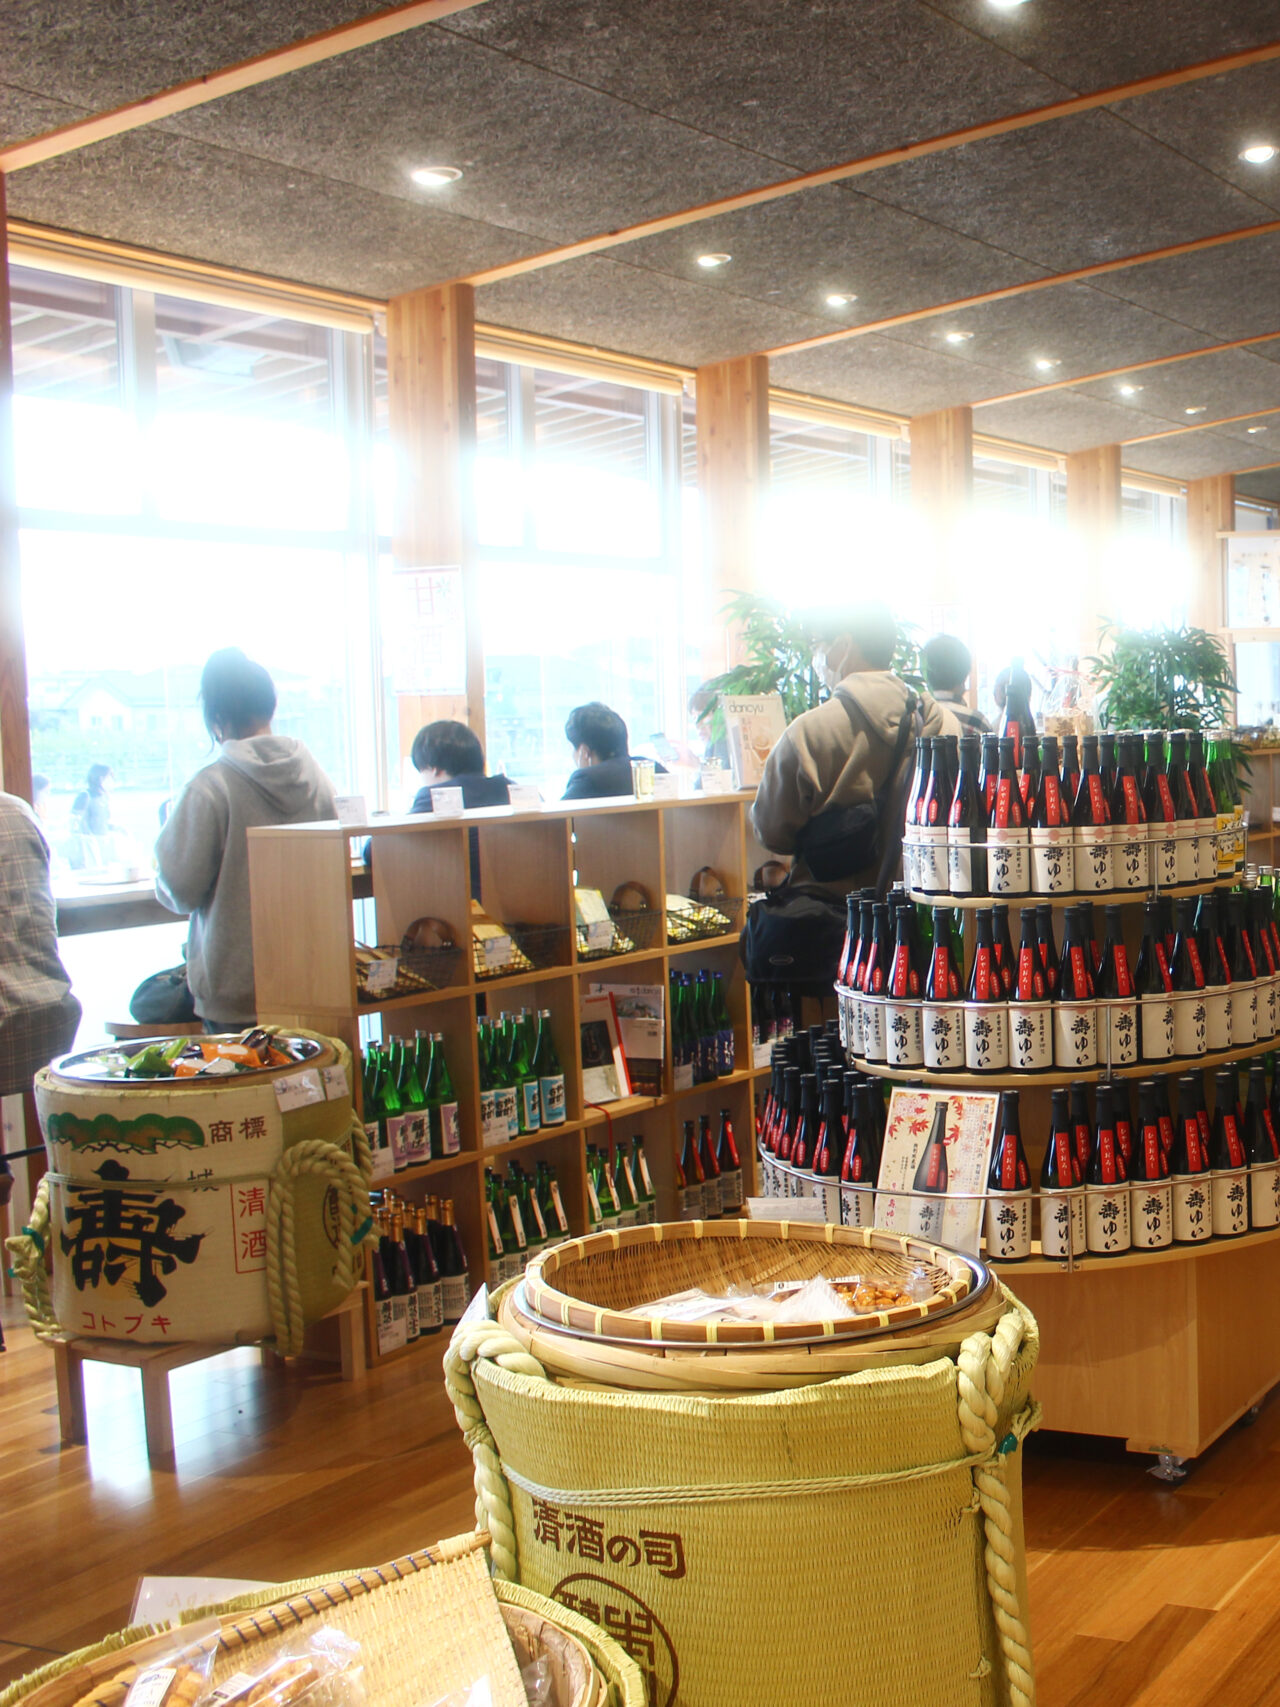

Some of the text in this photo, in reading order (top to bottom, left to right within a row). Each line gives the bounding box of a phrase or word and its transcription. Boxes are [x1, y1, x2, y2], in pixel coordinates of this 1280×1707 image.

[728, 701, 764, 716] dancyu
[979, 953, 987, 991] ひやおろし
[1022, 953, 1030, 991] ひやおろし
[209, 1116, 268, 1144] 商標
[1104, 1136, 1112, 1174] ひやおろし
[238, 1187, 267, 1260] 清酒
[82, 1311, 171, 1335] コトブキ
[532, 1500, 686, 1579] 清酒の司
